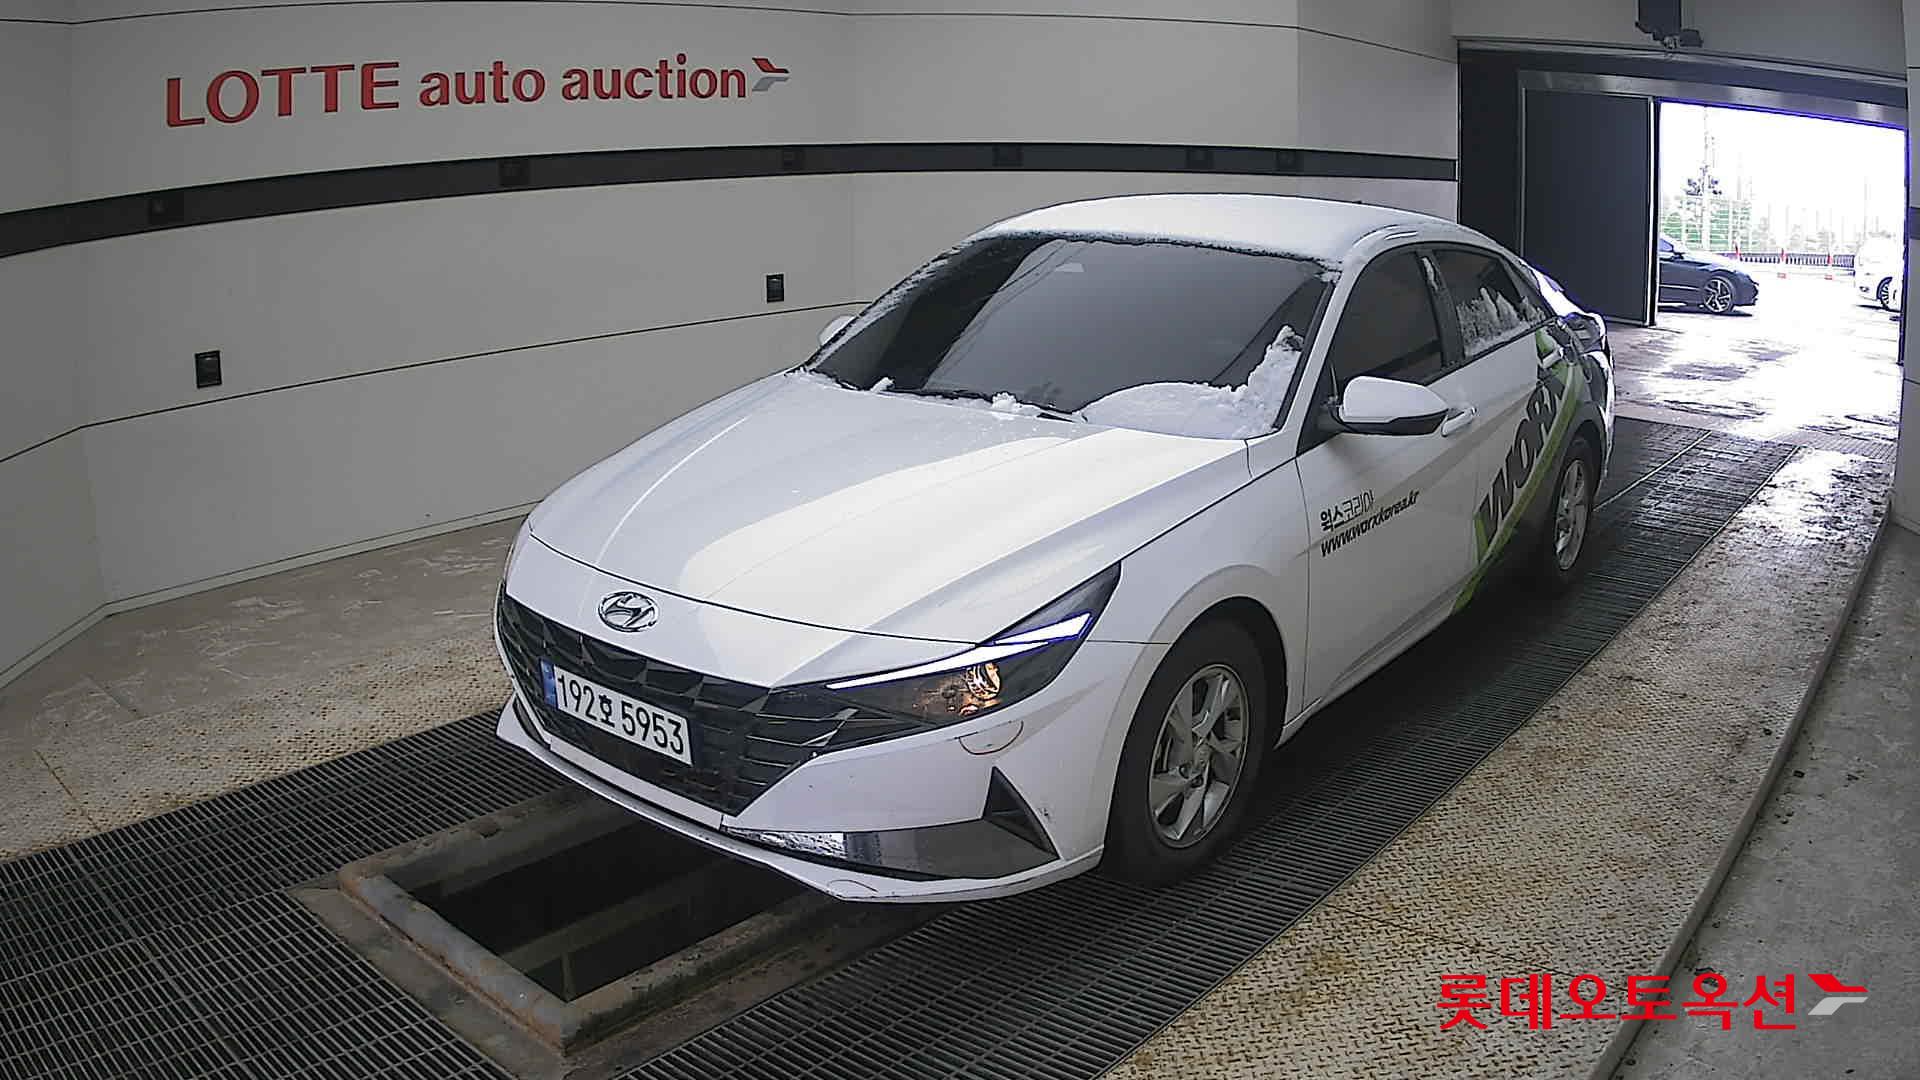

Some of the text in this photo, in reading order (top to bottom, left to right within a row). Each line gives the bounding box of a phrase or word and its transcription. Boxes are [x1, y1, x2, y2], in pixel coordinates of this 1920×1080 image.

[166, 53, 747, 127] LOTTE auto auction
[557, 674, 684, 756] 192호 5953
